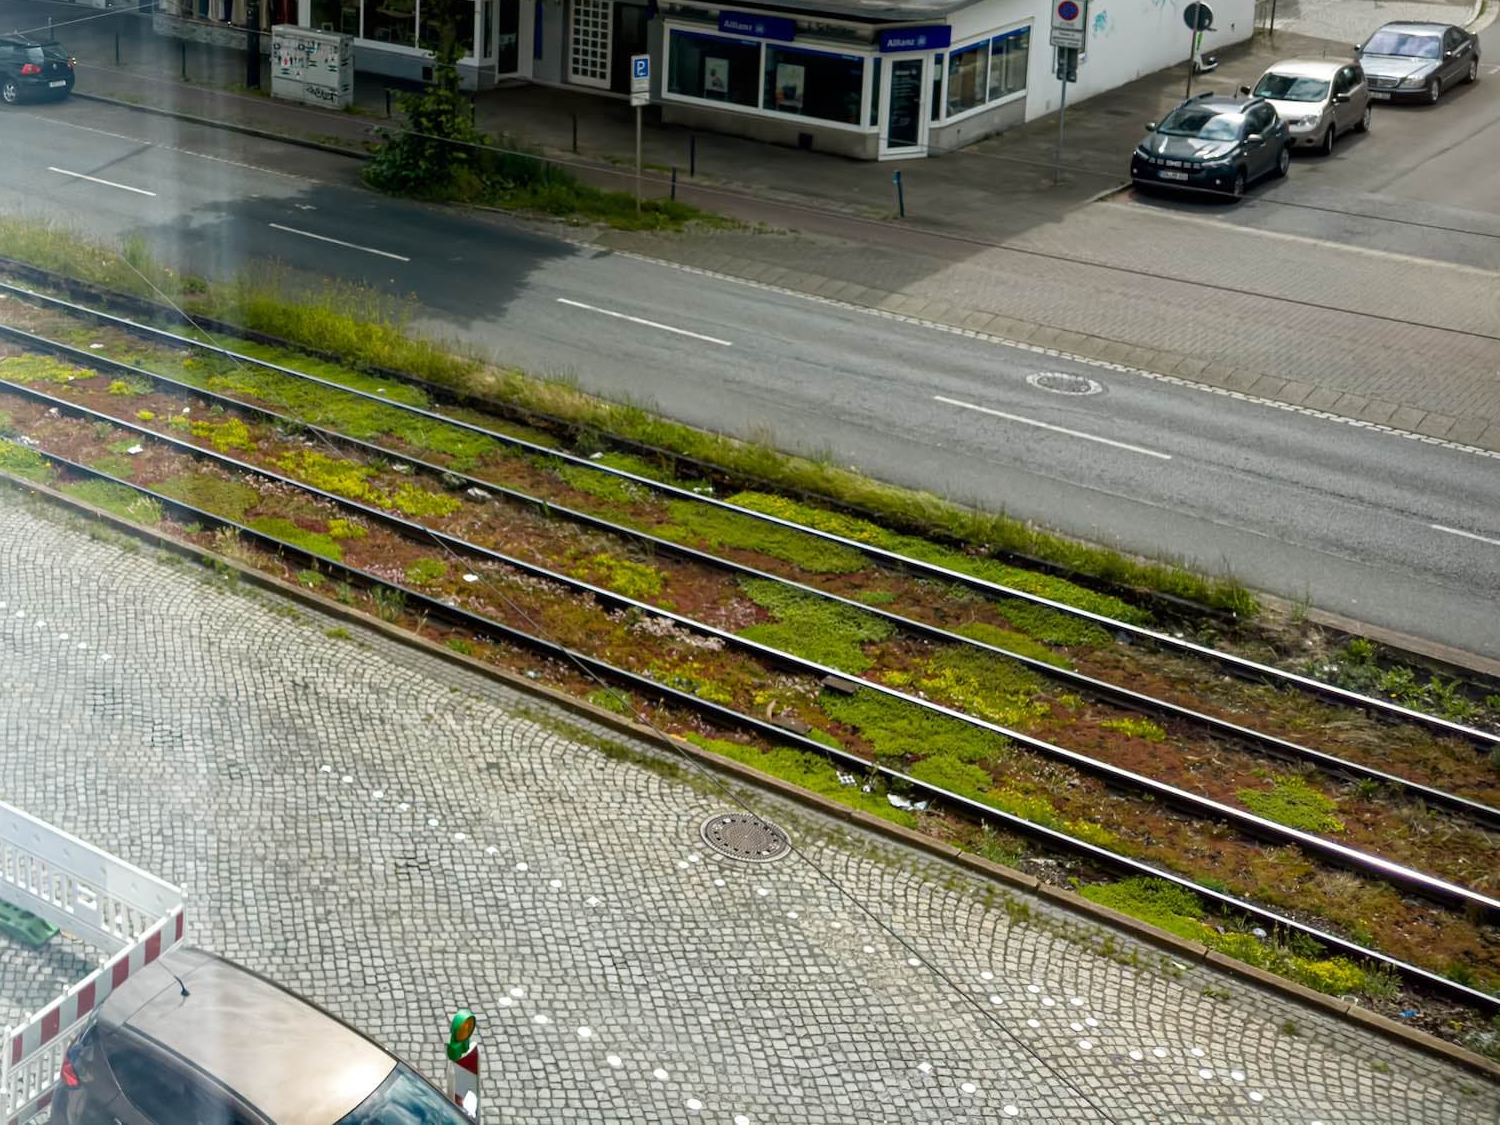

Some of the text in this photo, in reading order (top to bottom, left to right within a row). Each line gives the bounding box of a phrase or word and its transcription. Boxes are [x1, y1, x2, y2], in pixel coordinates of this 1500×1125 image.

[723, 19, 753, 31] Allianz
[887, 38, 915, 47] Allianz
[637, 60, 646, 76] P
